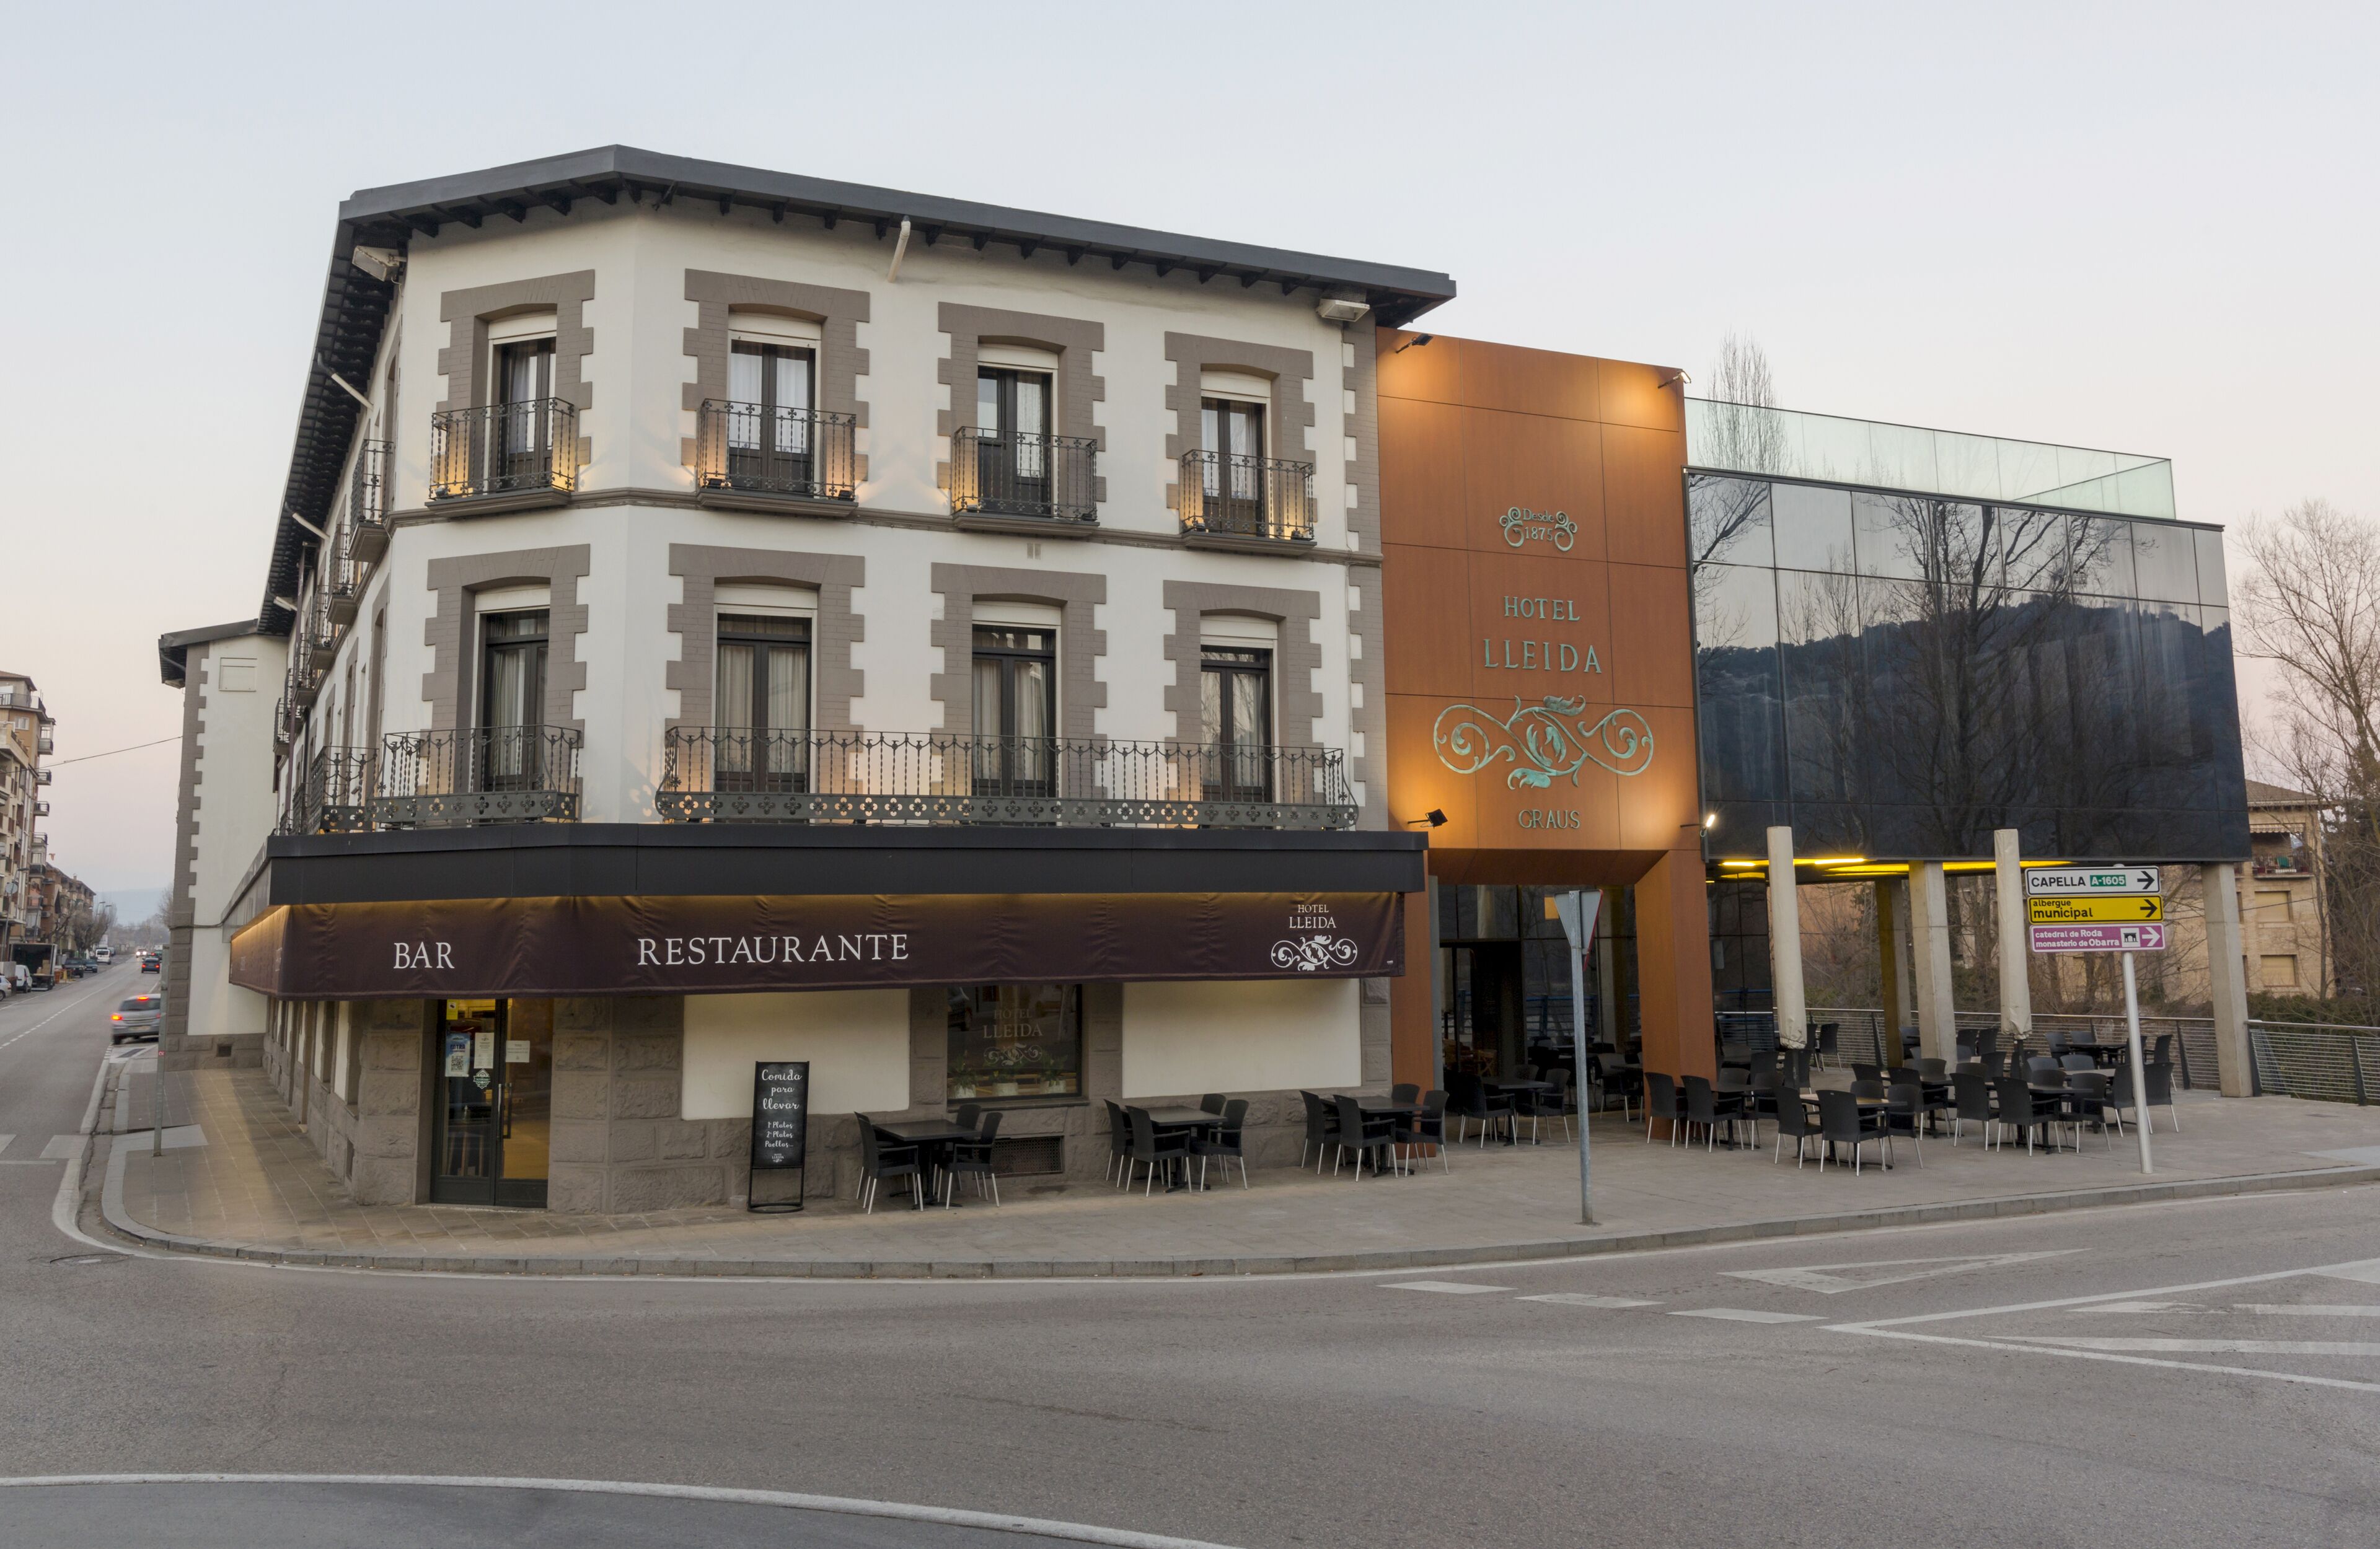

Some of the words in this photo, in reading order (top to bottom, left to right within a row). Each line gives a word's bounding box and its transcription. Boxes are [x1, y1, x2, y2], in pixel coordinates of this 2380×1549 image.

[1523, 509, 1554, 523] Desde
[1524, 526, 1553, 541] 1875
[1504, 595, 1580, 621] HOTEL
[1483, 638, 1602, 674] LLEIDA
[1518, 809, 1581, 829] GRAUS
[2031, 877, 2086, 887] CAPELLA
[2092, 876, 2125, 885] A-1605
[1298, 904, 1329, 913] HOTEL
[2033, 899, 2071, 908] albergue
[2034, 908, 2093, 919] municipal
[1289, 916, 1337, 929] LLEIDA
[2035, 930, 2068, 938] catedral
[2036, 939, 2077, 947] monasterio
[2089, 938, 2120, 946] Obarra
[394, 941, 455, 969] BAR
[637, 934, 909, 966] RESTAURANTE
[994, 1008, 1033, 1020] HOTEL
[982, 1022, 1043, 1038] LLEIDA
[762, 1069, 803, 1081] Comida
[771, 1086, 795, 1097] para
[763, 1098, 800, 1110] llevar
[772, 1121, 793, 1129] Platos
[773, 1130, 793, 1139] Platos
